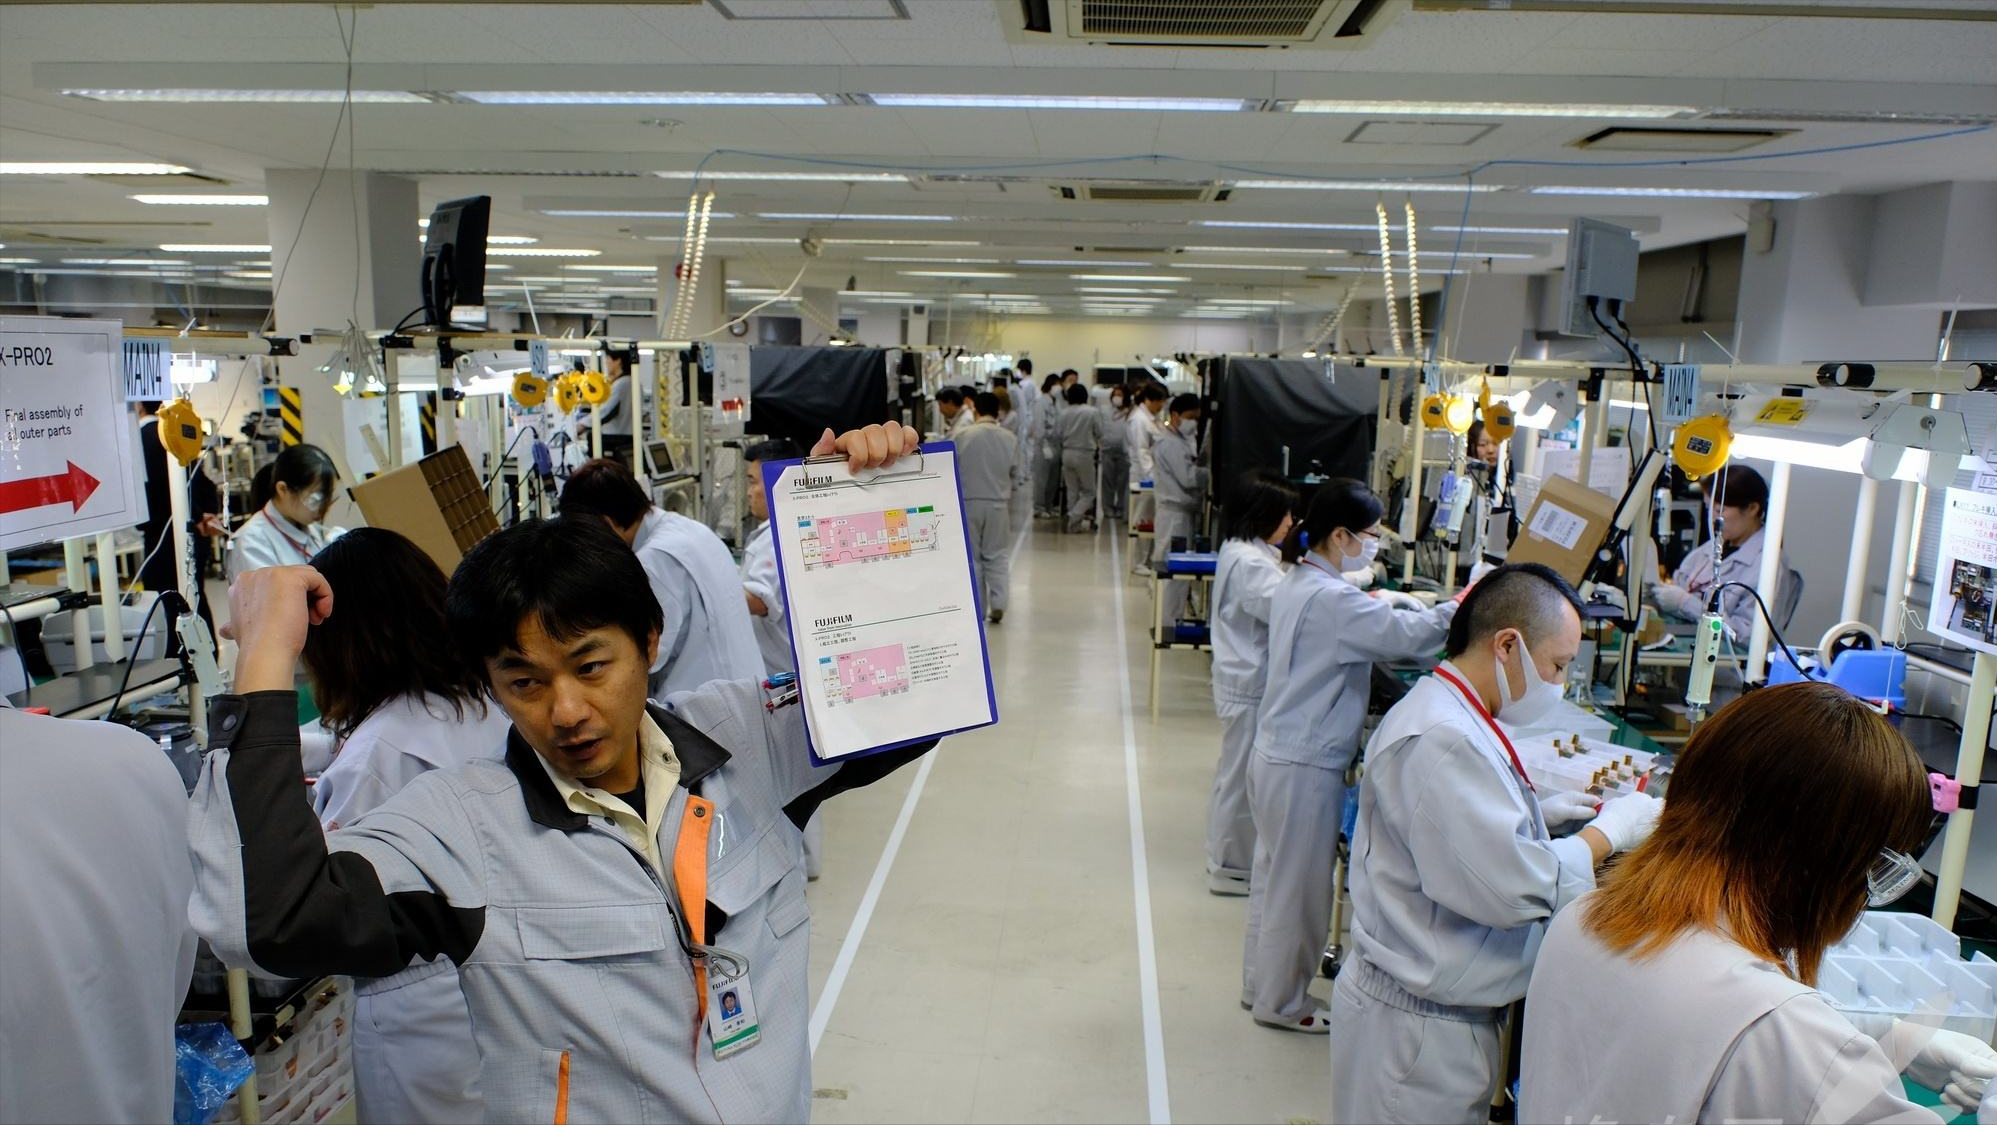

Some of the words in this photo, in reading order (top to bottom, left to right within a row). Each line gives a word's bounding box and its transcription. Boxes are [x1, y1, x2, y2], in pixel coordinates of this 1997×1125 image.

[123, 342, 162, 396] MAIN4
[1666, 367, 1695, 417] MAIN4
[5, 407, 26, 422] Fnal
[29, 404, 71, 420] assembly
[74, 403, 83, 416] of
[8, 425, 18, 441] al
[20, 426, 45, 440] outer
[47, 422, 72, 439] parts
[814, 614, 853, 628] FUJIFILM
